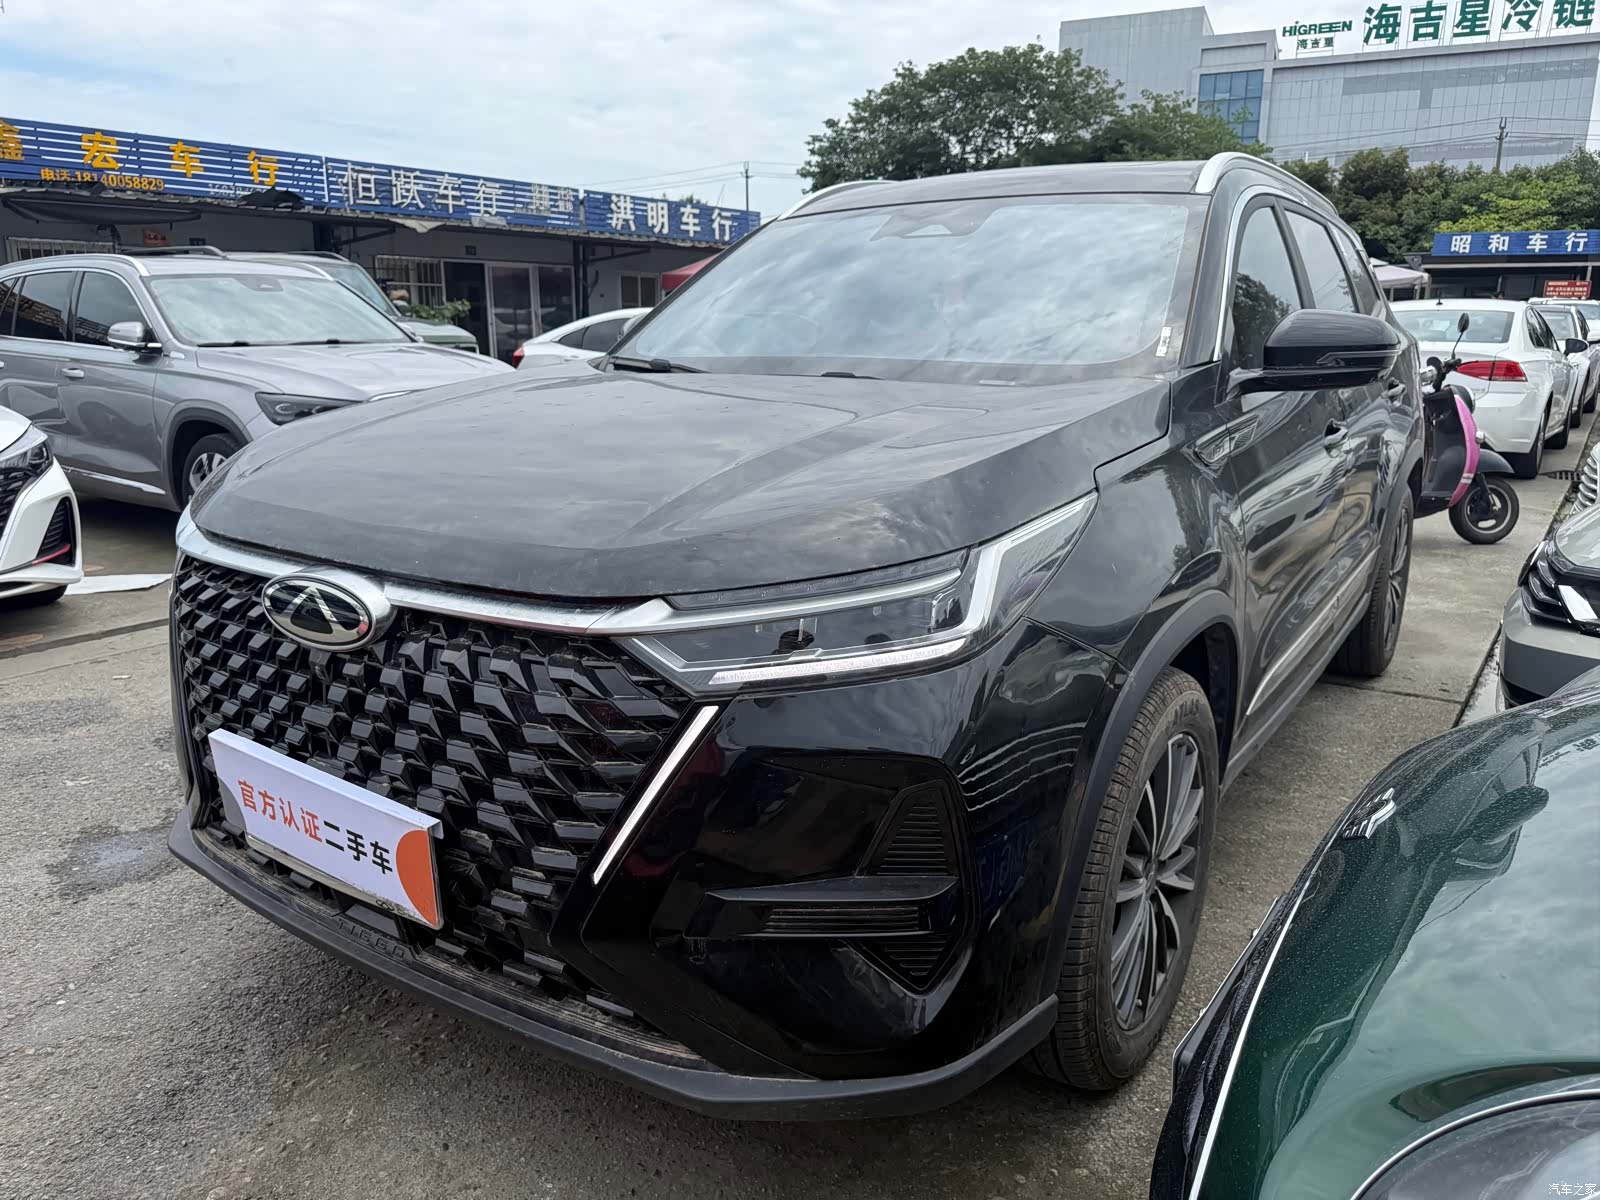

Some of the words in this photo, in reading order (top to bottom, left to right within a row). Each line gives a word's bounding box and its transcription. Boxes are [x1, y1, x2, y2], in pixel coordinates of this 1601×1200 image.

[1297, 37, 1334, 50] 海吉星
[1363, 0, 1595, 45] 海吉星冷链
[342, 161, 502, 217] 恒跃车行
[610, 194, 734, 242] 洪明车行
[1450, 232, 1589, 254] 昭和车行
[238, 779, 393, 874] 官方认证二手车
